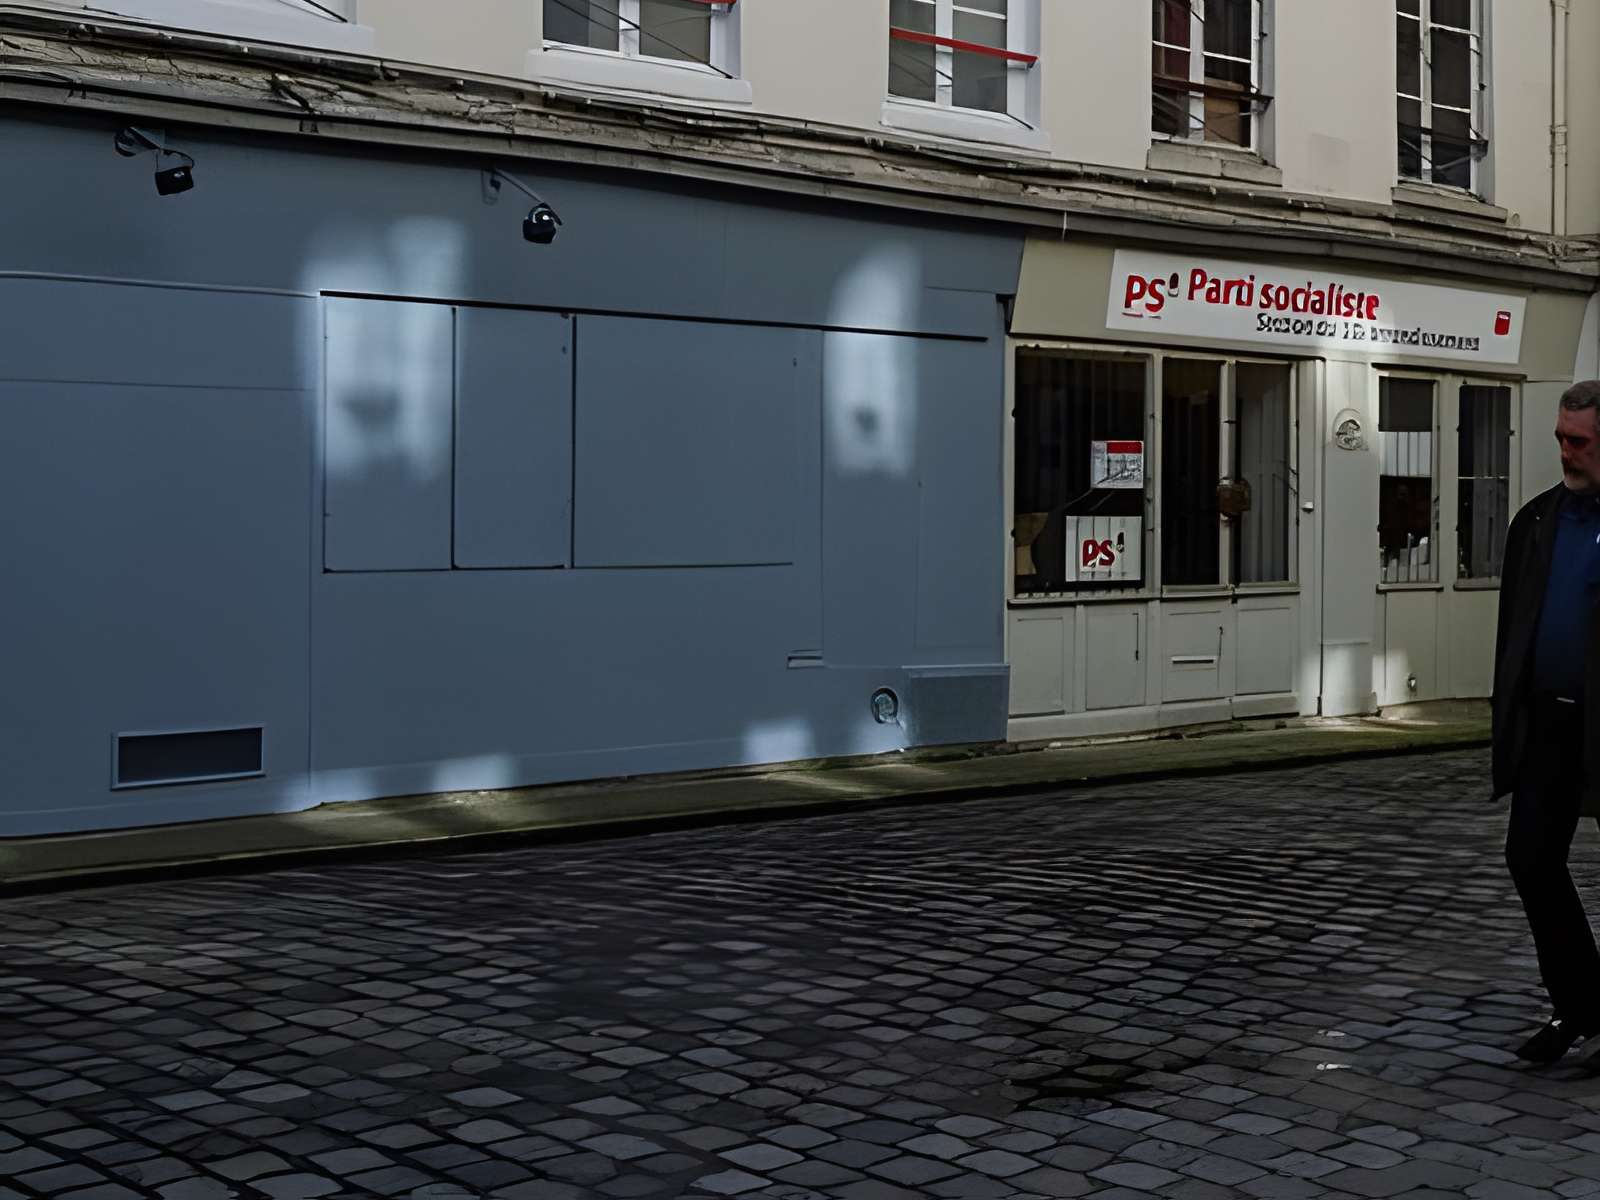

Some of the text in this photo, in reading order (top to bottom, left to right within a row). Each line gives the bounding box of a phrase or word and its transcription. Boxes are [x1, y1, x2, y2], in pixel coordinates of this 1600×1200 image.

[1124, 273, 1166, 313] PS
[1187, 267, 1381, 321] Parti socialiste
